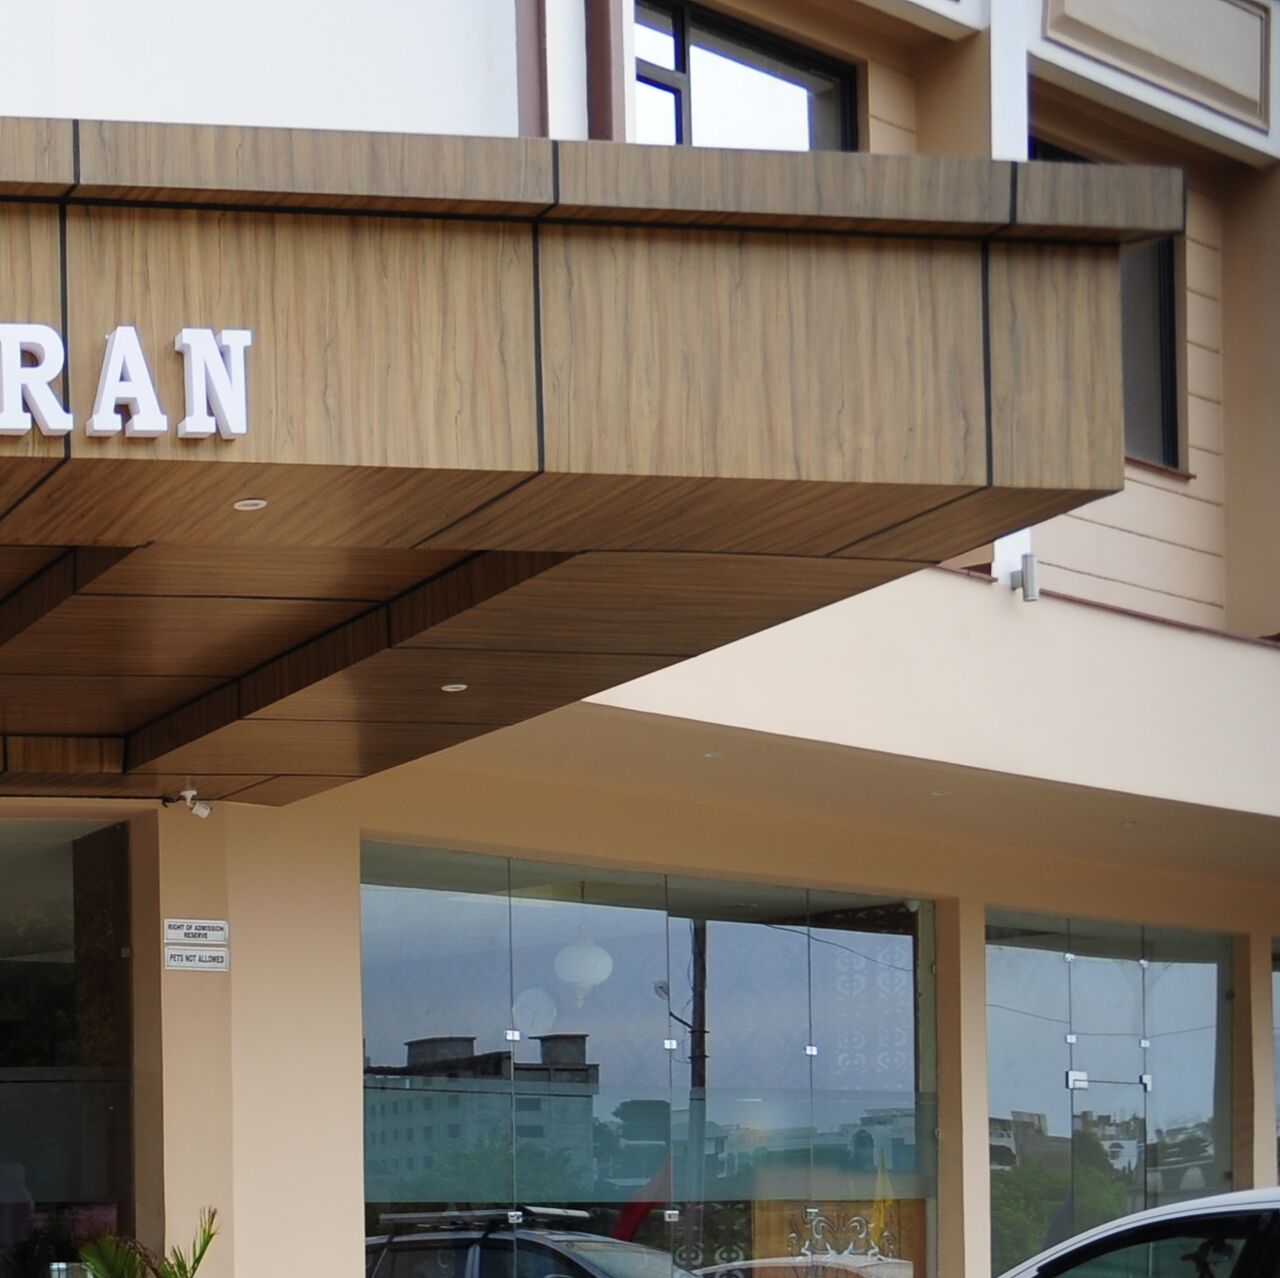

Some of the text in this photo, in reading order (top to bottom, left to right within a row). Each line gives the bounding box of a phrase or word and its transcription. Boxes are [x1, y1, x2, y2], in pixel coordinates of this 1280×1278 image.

[169, 953, 224, 964] PETS NOT ALLOWED
